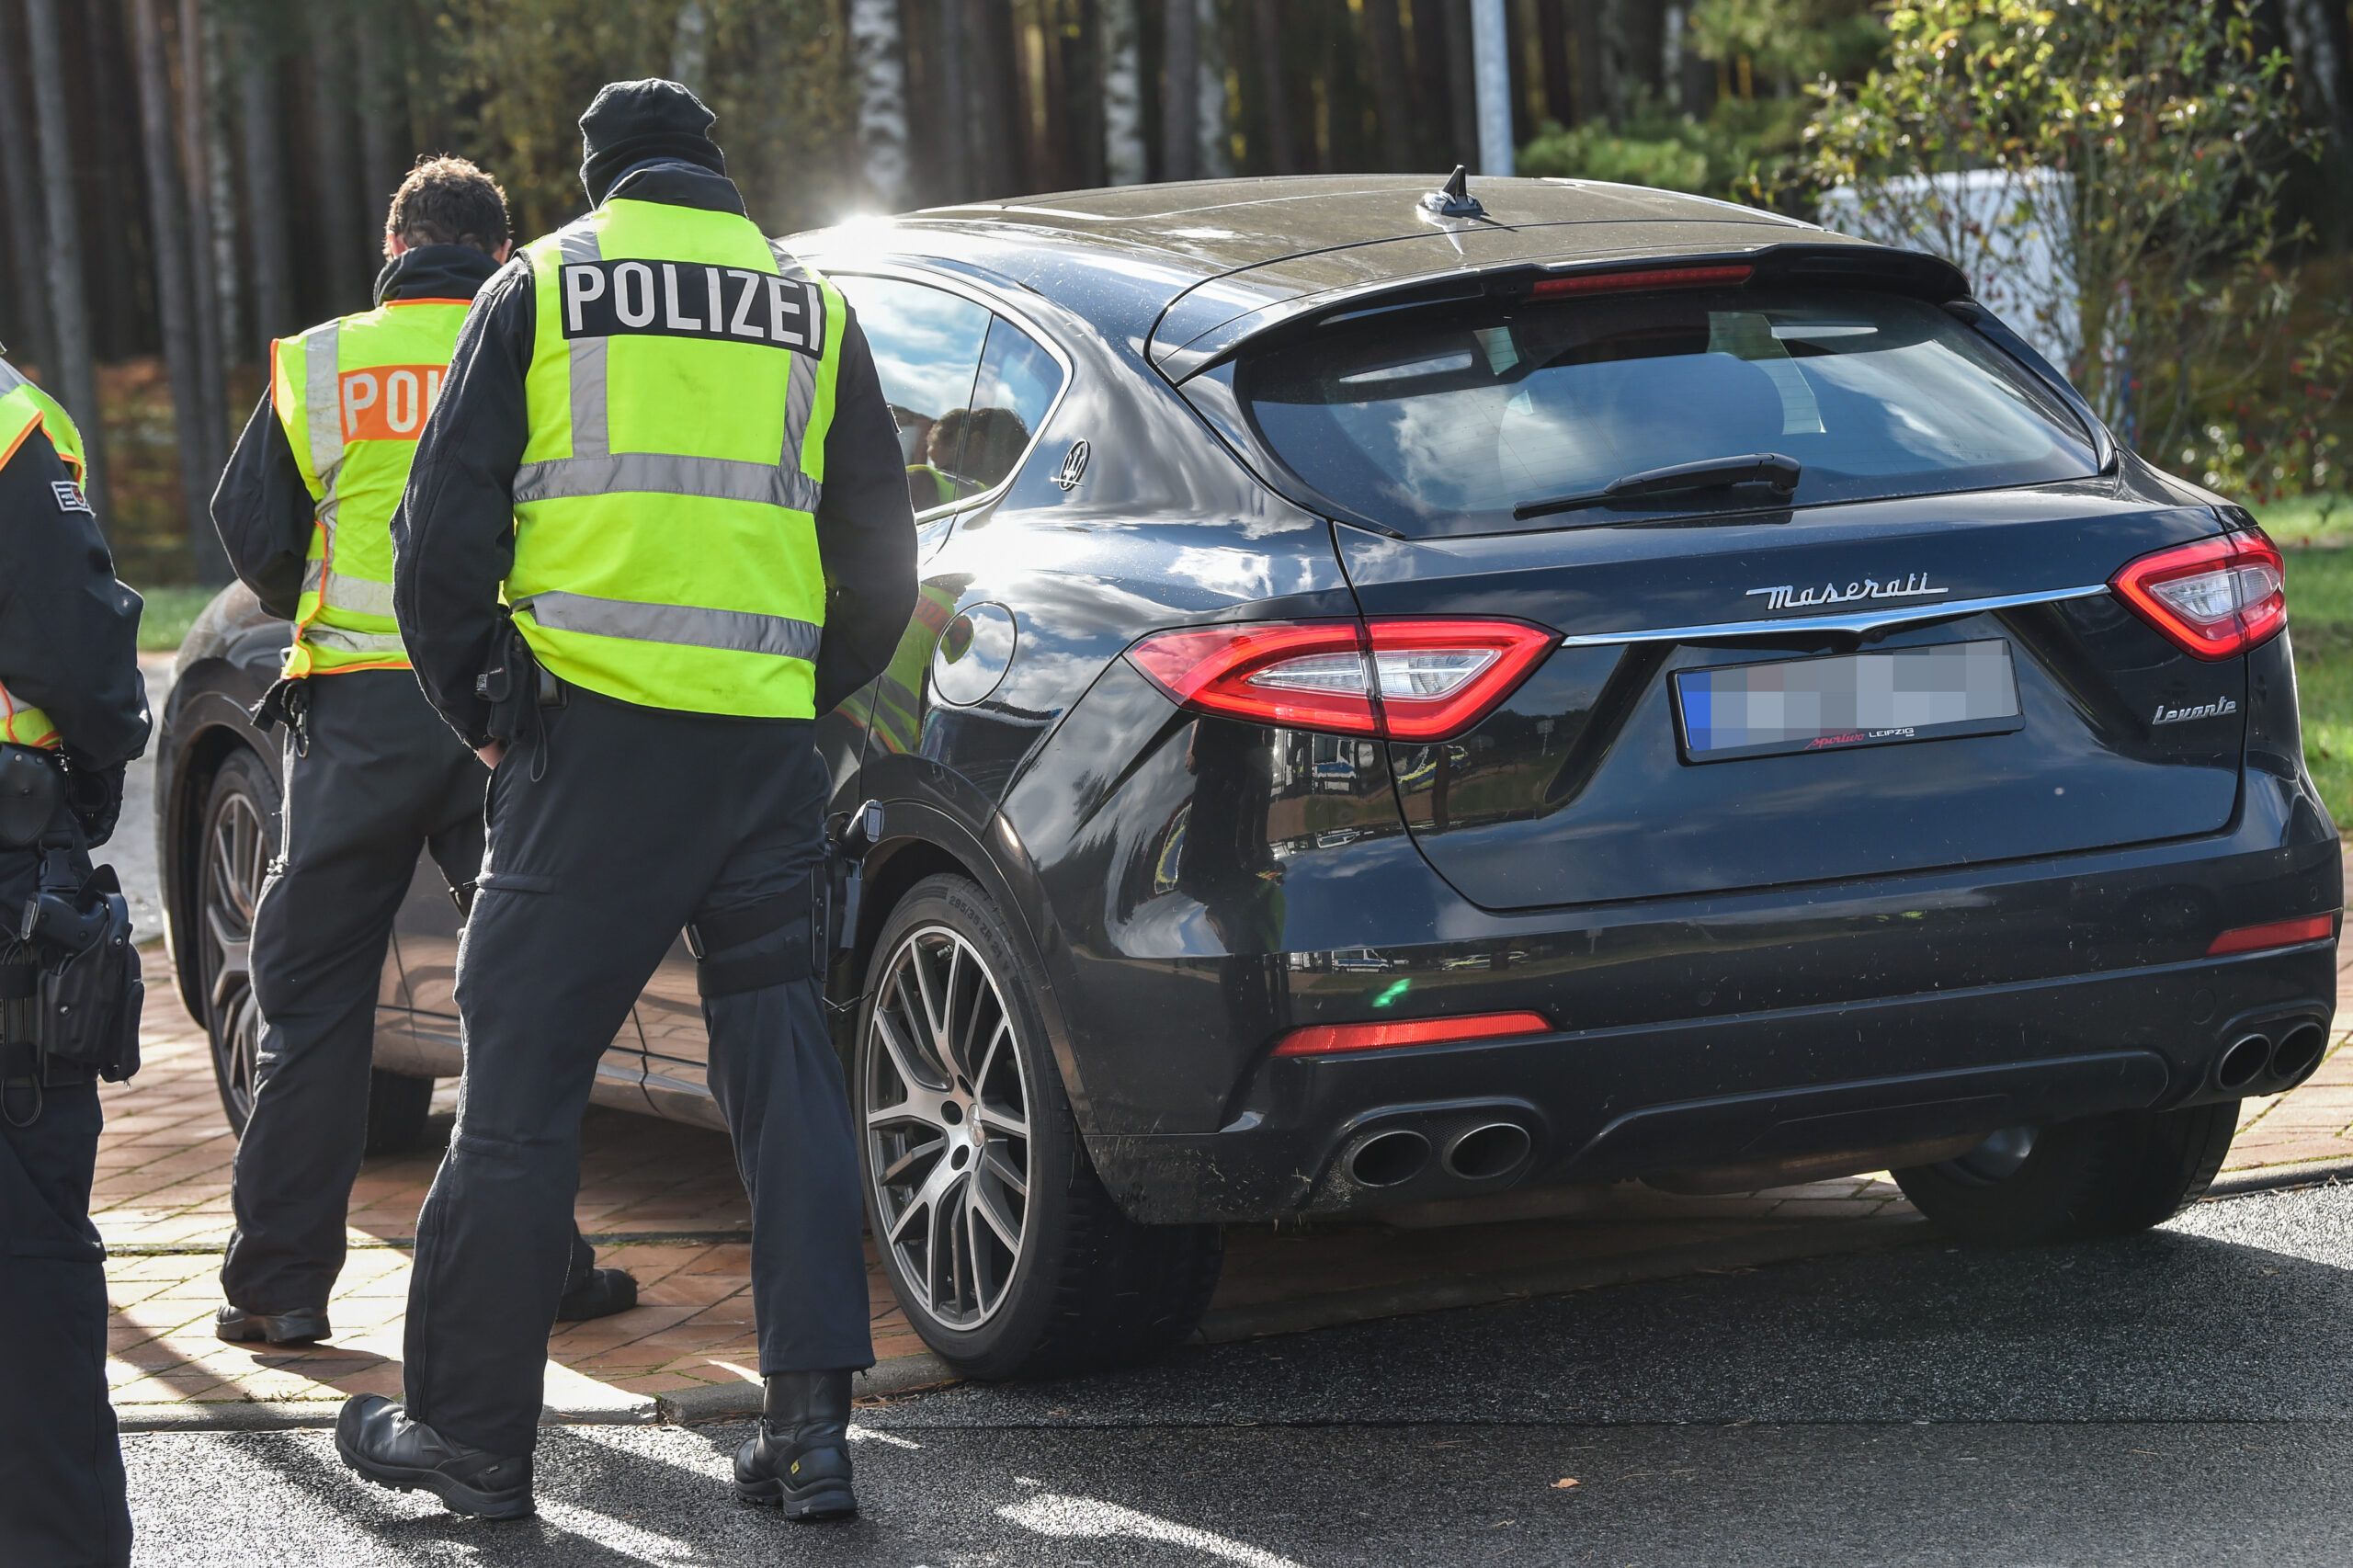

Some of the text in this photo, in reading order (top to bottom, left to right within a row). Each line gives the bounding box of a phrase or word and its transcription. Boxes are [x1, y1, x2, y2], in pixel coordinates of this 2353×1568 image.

[564, 261, 822, 352] POLIZEI
[1746, 572, 1949, 609] Maserati
[2152, 696, 2237, 725] Levante
[1869, 727, 1915, 738] LEIPZIG
[949, 895, 982, 926] 295/35
[979, 922, 993, 942] ZR
